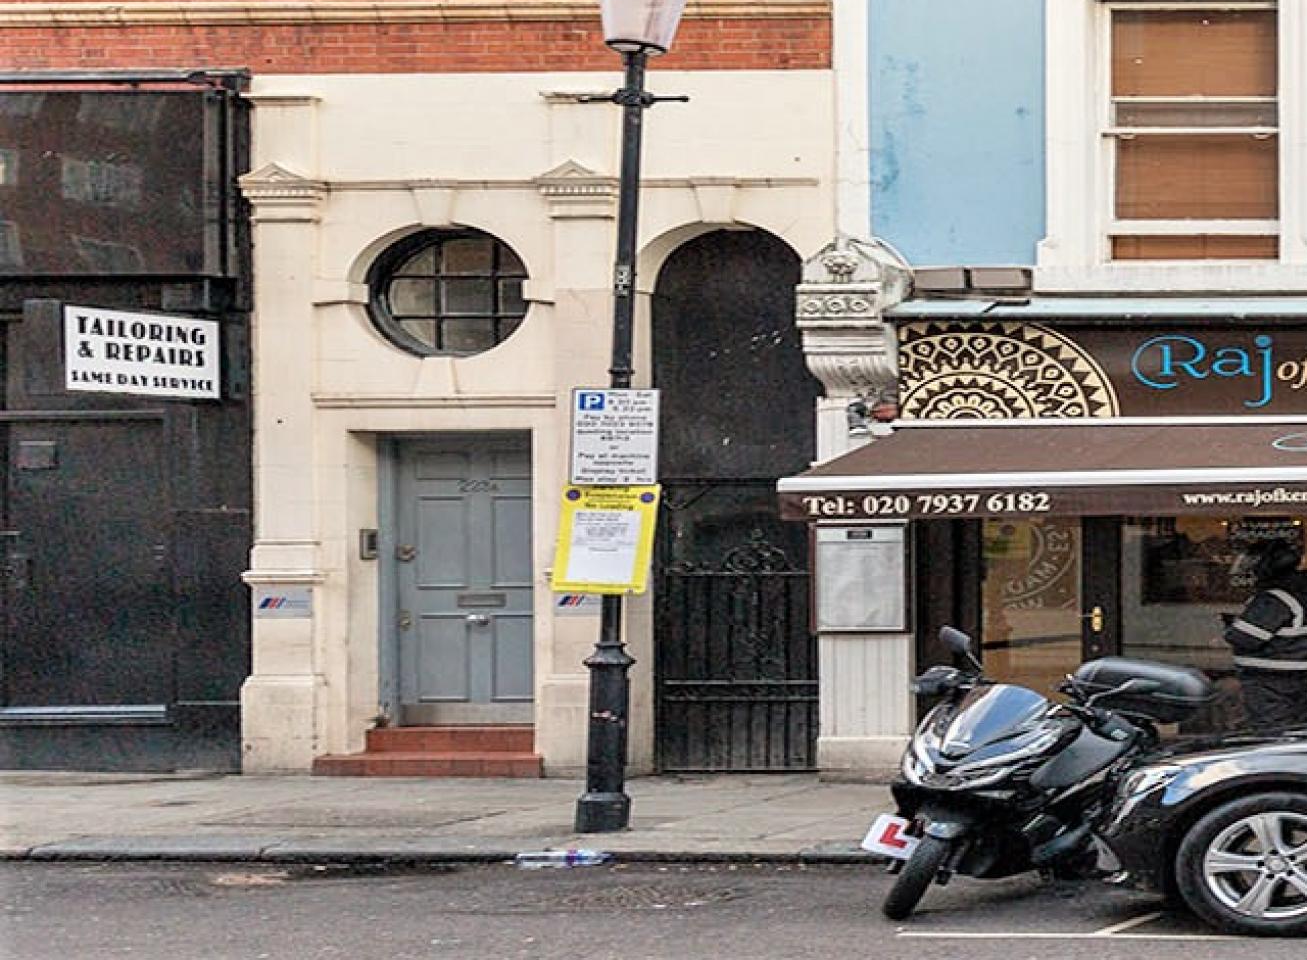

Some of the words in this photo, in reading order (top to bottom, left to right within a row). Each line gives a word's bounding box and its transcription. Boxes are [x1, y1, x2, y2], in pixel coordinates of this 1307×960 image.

[76, 316, 206, 345] TAILORING
[77, 341, 94, 358] &
[105, 342, 205, 367] REPAIRS
[72, 370, 112, 384] SAME
[117, 373, 148, 387] DAY
[152, 375, 214, 392] SERVICE
[1130, 334, 1273, 408] Raj
[585, 395, 601, 410] P
[802, 495, 854, 515] Tel:
[863, 495, 910, 514] 020
[917, 493, 980, 513] 7937
[986, 492, 1051, 512] 6182
[880, 823, 908, 848] L
